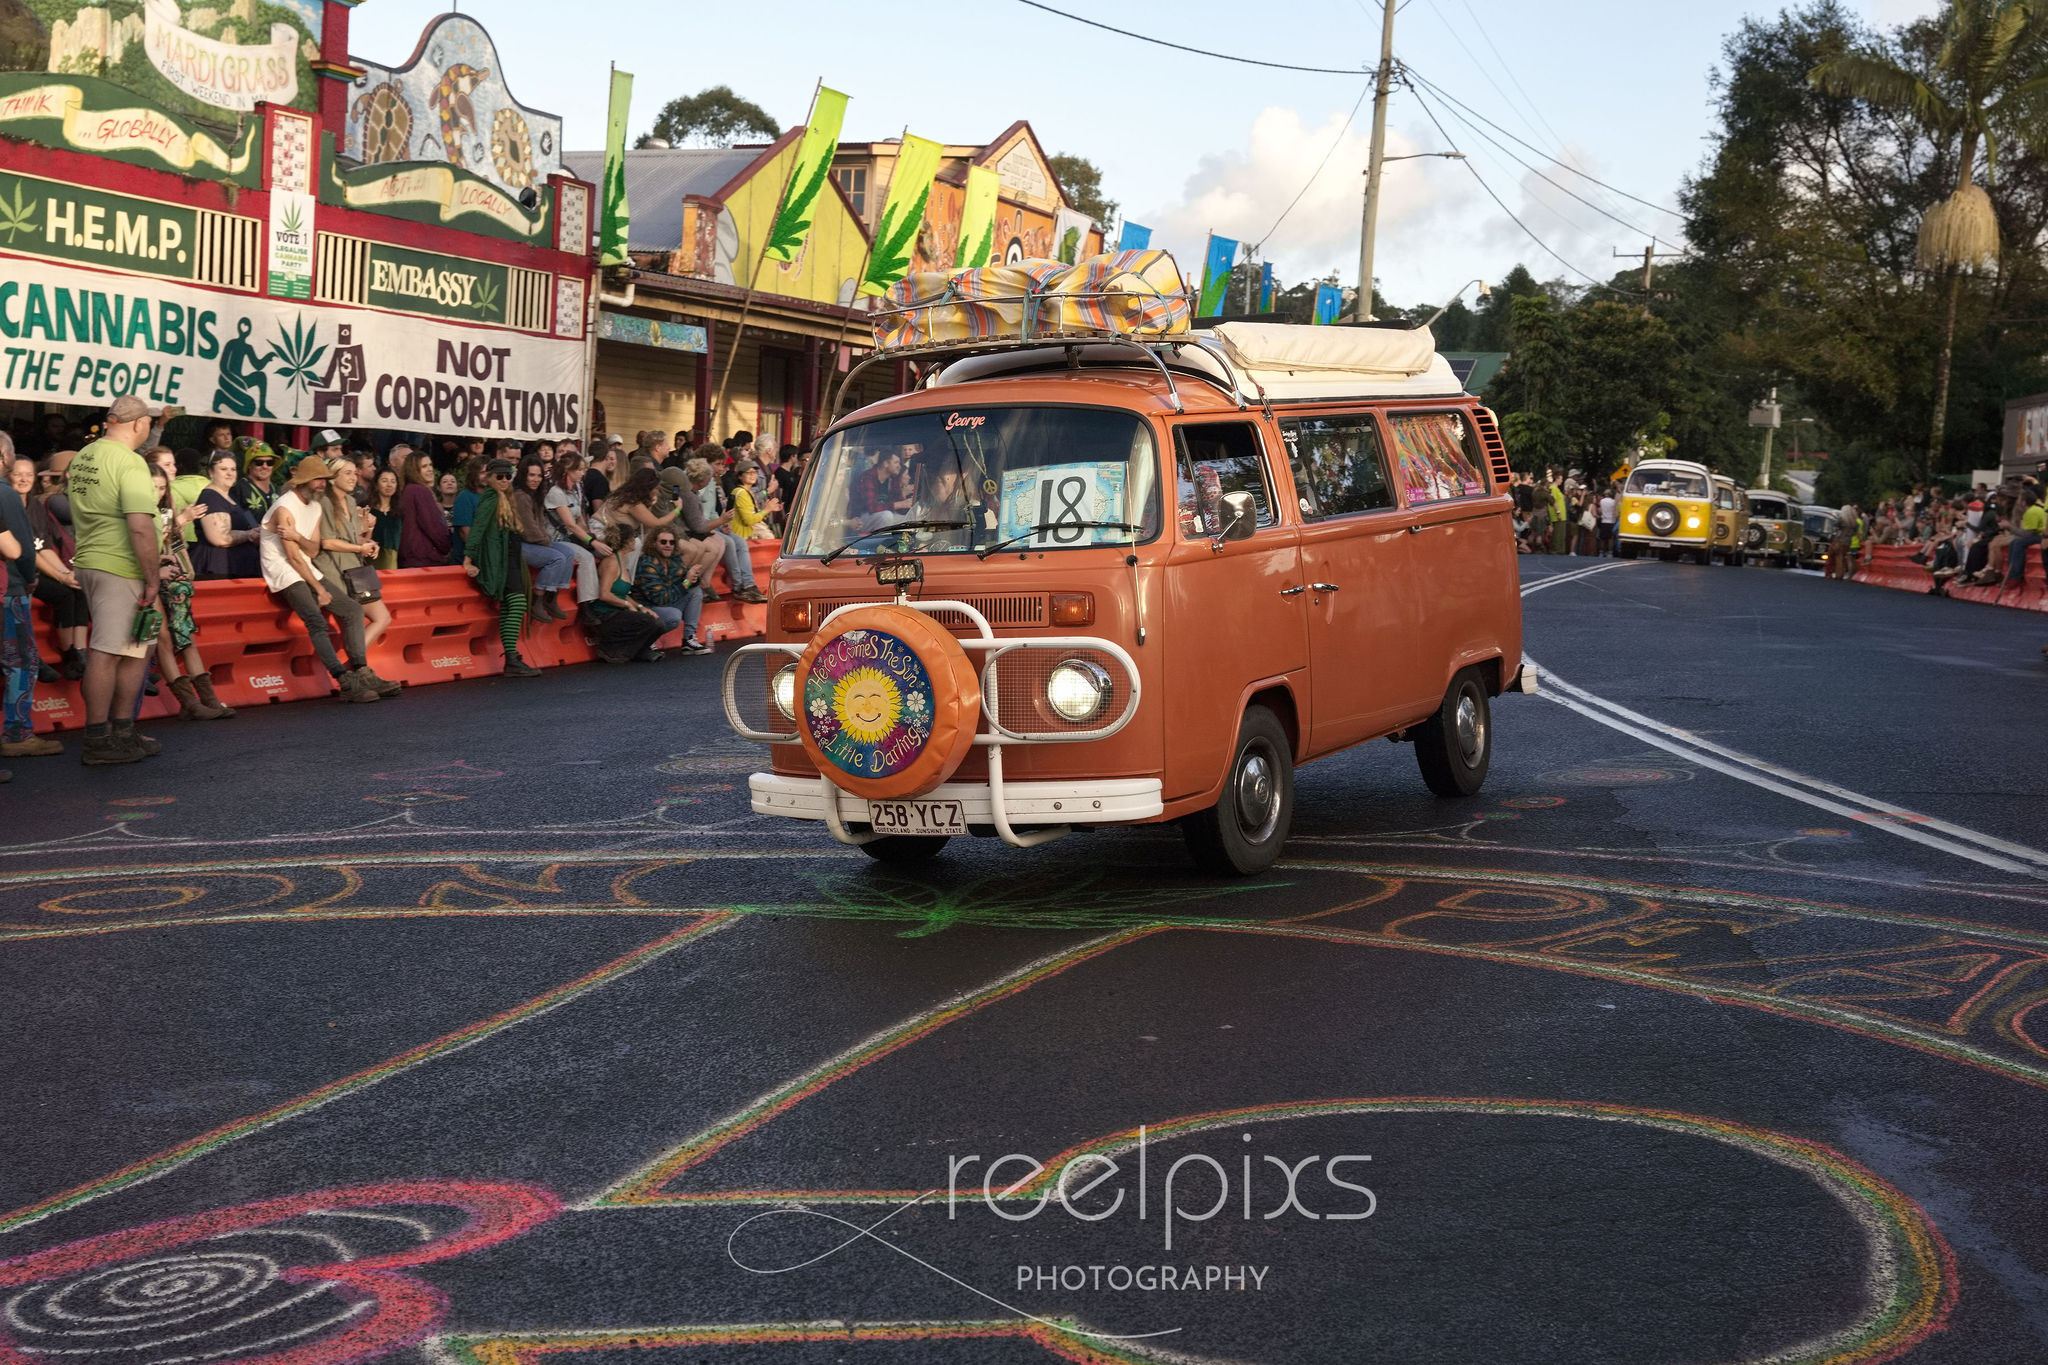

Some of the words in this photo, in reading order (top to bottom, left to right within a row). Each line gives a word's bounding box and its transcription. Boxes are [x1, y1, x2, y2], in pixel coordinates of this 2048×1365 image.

[156, 24, 217, 88] MARDI
[221, 55, 290, 93] GRASS
[2, 94, 52, 116] THINK
[160, 60, 186, 84] FIRST
[191, 82, 231, 107] WEEKEND
[237, 94, 246, 108] IN
[460, 186, 513, 216] LOCALLY
[46, 198, 187, 263] H.E.M.P.
[276, 231, 300, 245] VOTE
[276, 245, 308, 255] LEGALISE
[370, 259, 478, 307] EMBASSY
[0, 281, 219, 360] CANNABIS
[4, 347, 65, 391] THE
[69, 356, 184, 405] PEOPLE
[436, 338, 511, 382] NOT
[375, 373, 578, 434] CORPORATIONS
[945, 412, 986, 431] George
[1038, 476, 1086, 544] 18
[249, 674, 285, 689] Coates
[807, 654, 838, 691] Here
[880, 638, 899, 669] The
[892, 655, 918, 688] Sun
[31, 697, 70, 712] Coates
[825, 733, 863, 768] Little
[870, 726, 922, 773] Darling
[915, 827, 943, 835] SUNSHINE
